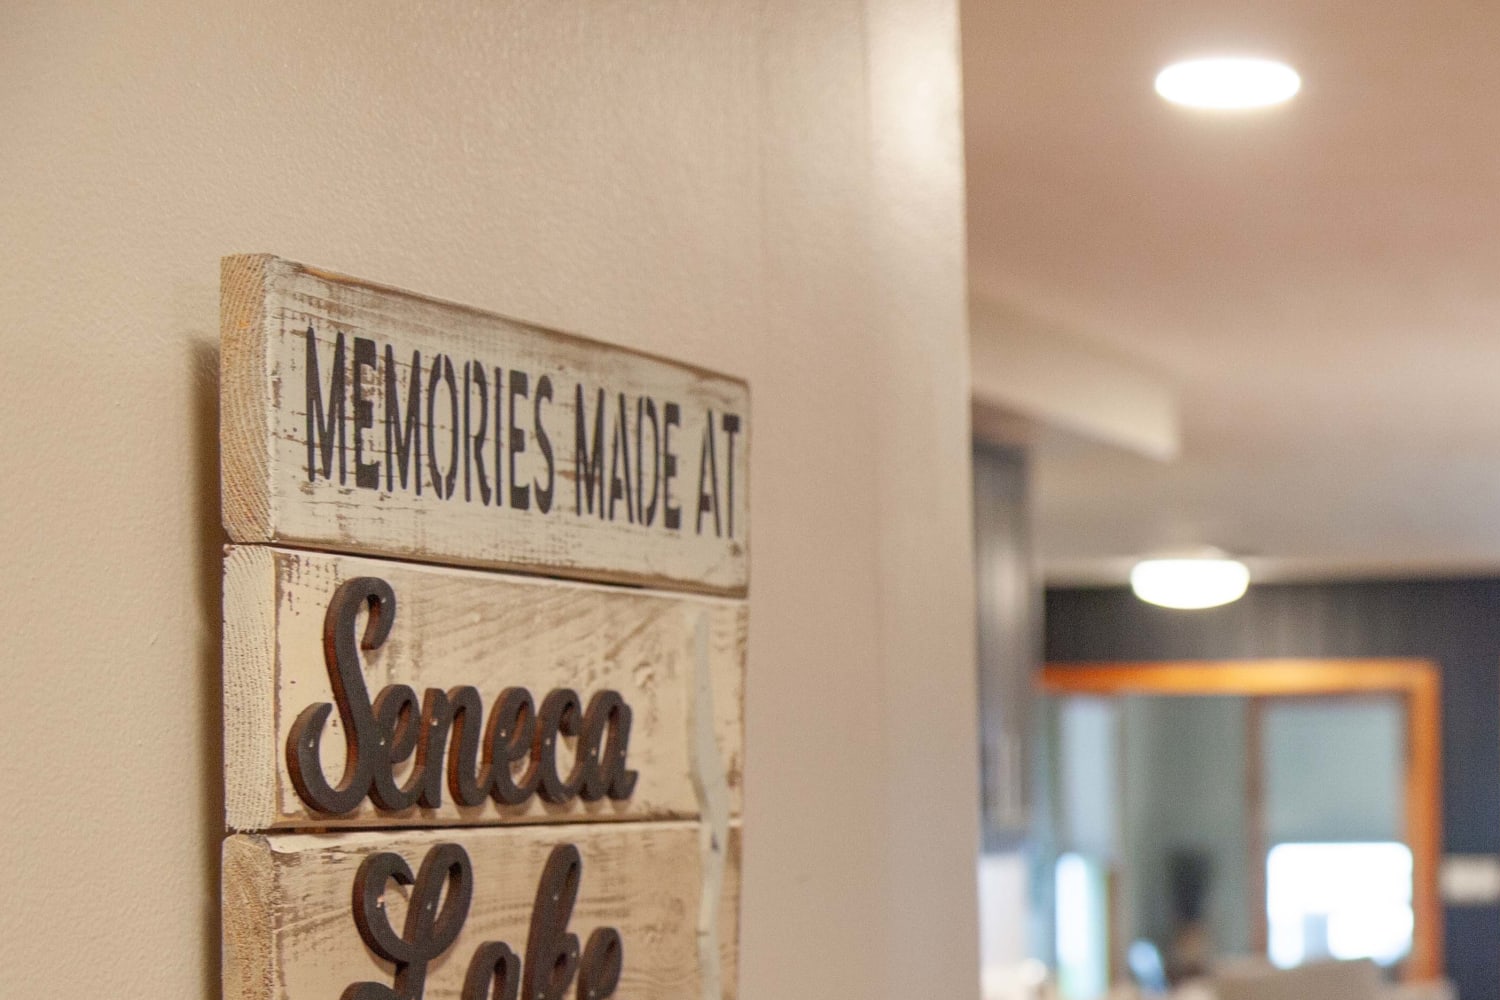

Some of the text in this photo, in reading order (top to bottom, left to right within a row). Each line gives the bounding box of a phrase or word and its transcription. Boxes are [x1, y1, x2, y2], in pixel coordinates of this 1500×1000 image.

[305, 326, 741, 539] MEMORIES MADE AT
[286, 576, 639, 814] Seneca
